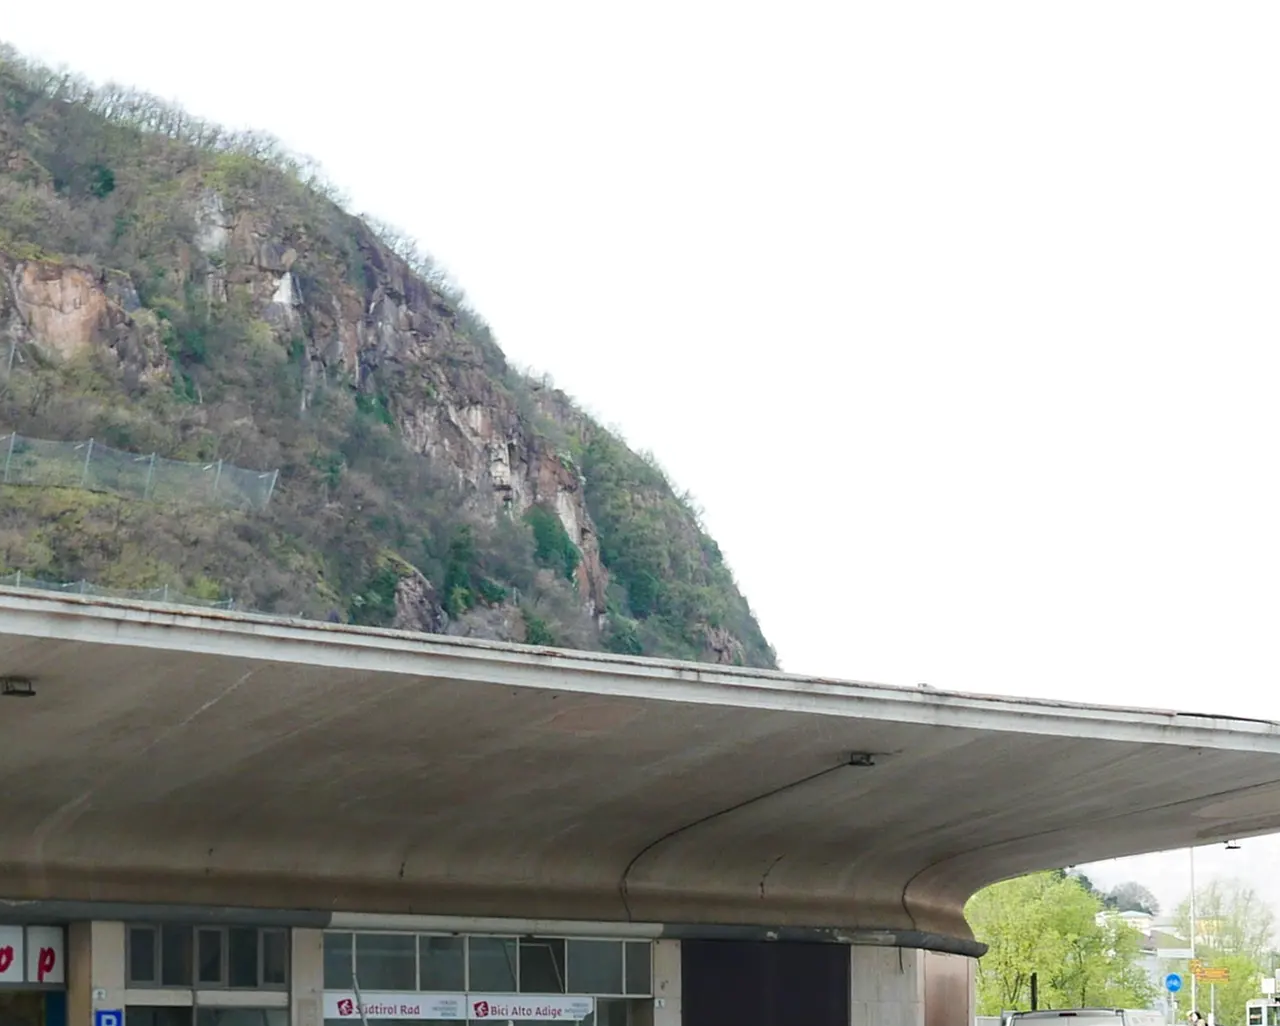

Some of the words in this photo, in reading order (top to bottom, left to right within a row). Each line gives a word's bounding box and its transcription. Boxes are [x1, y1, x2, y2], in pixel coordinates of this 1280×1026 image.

[400, 1004, 420, 1015] Rad
[490, 1005, 509, 1016] Bici
[511, 1005, 532, 1016] Alto
[535, 1005, 563, 1019] Adige
